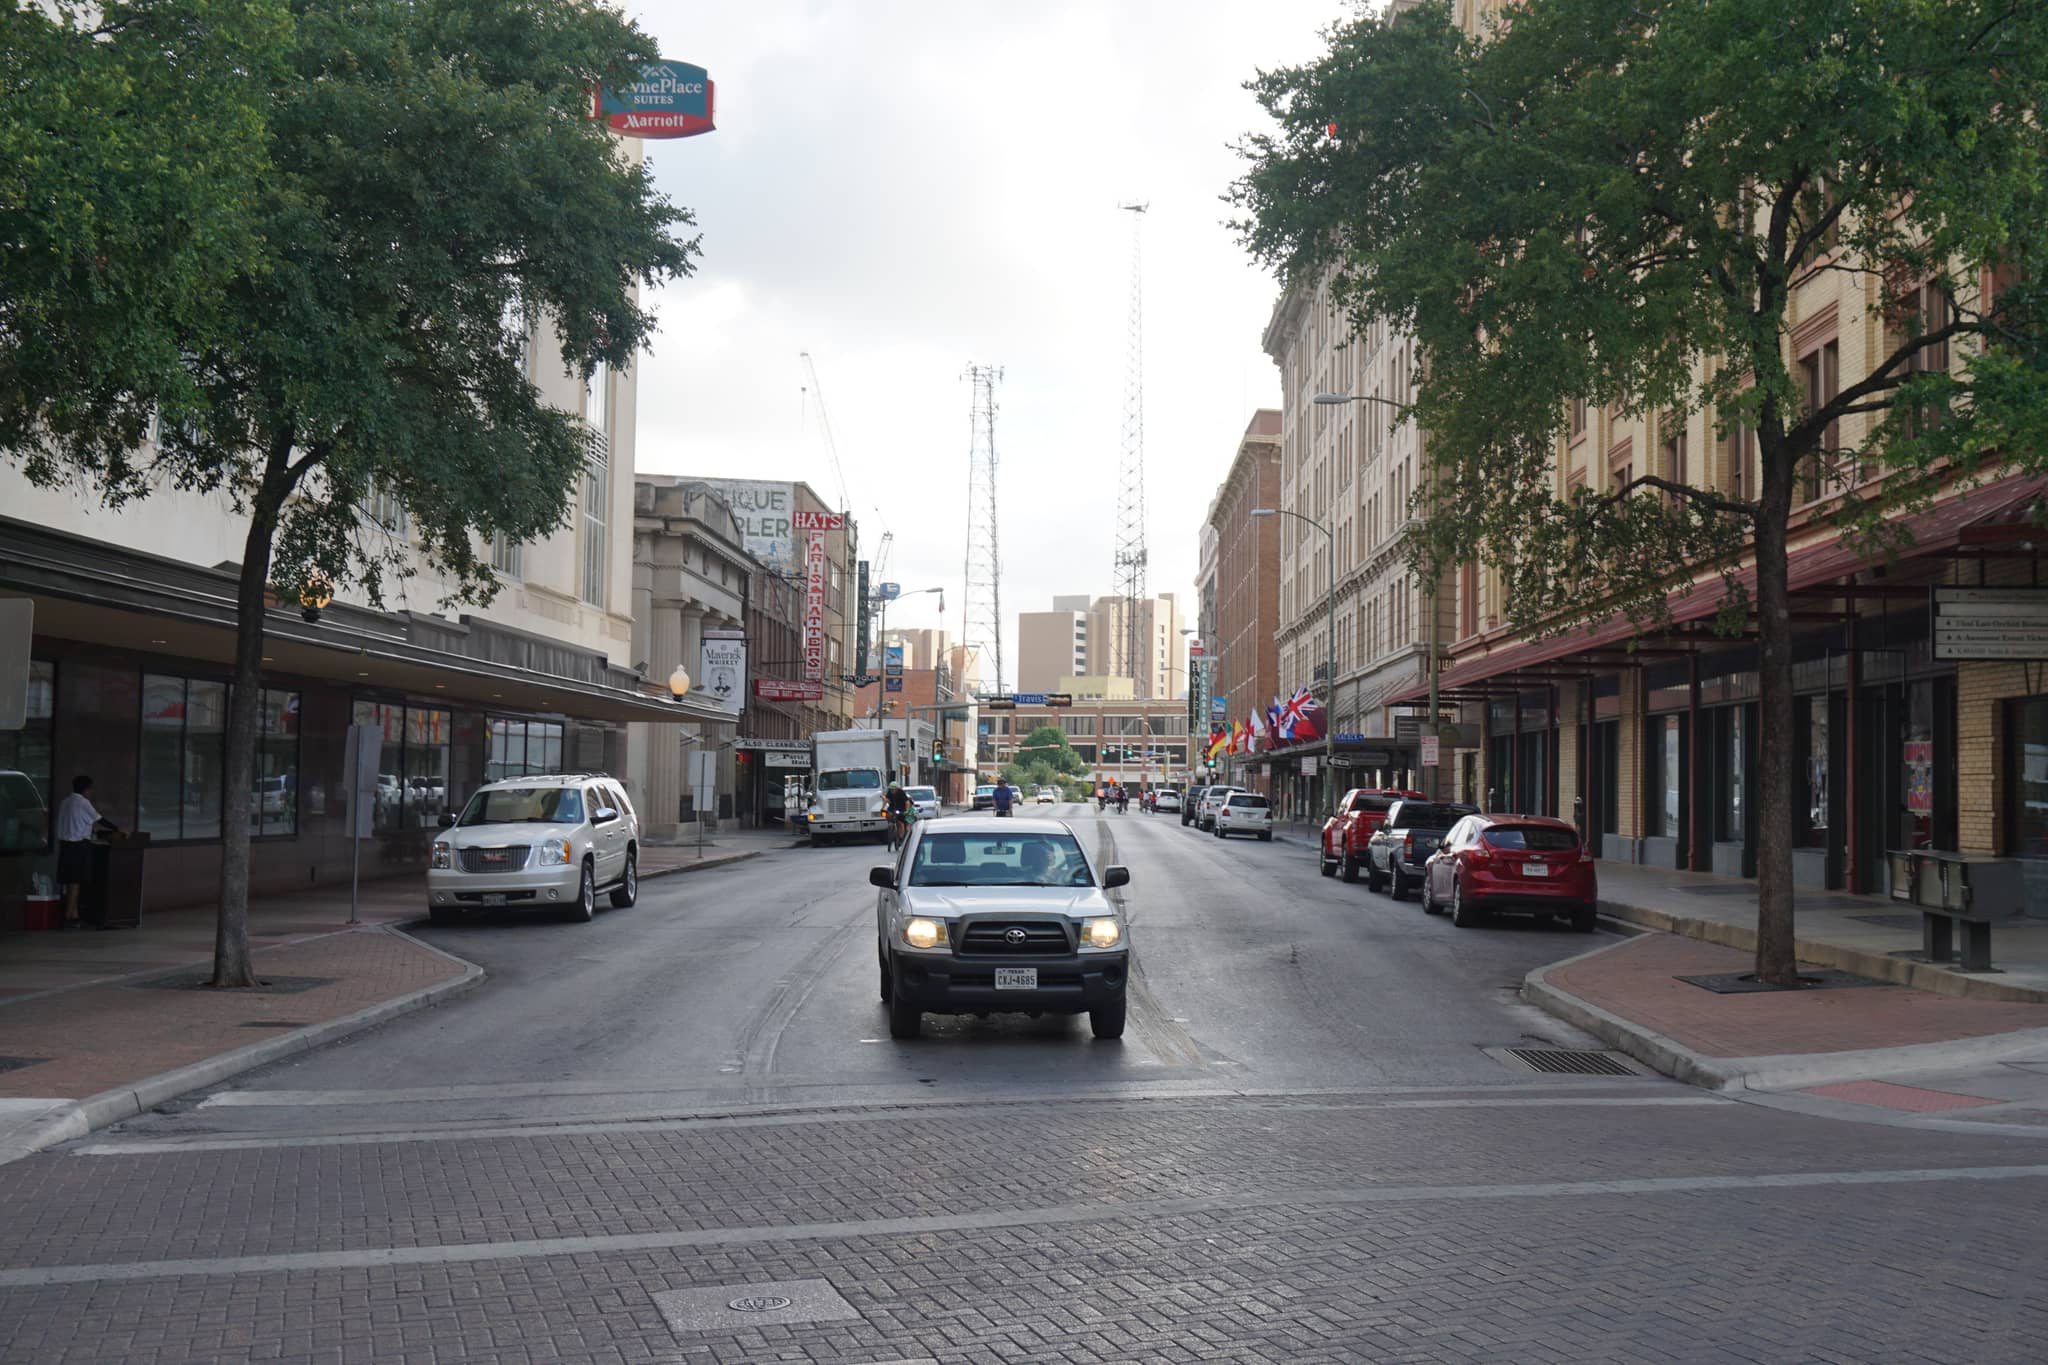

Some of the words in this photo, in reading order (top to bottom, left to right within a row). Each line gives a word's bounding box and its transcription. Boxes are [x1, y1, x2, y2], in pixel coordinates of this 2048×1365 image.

[618, 78, 703, 94] wnePlace
[634, 95, 674, 104] SUITES
[623, 115, 684, 128] Marriott
[795, 513, 842, 529] HATS
[811, 532, 823, 583] PARIS
[808, 595, 821, 667] HATTERS
[1019, 695, 1042, 703] Travis
